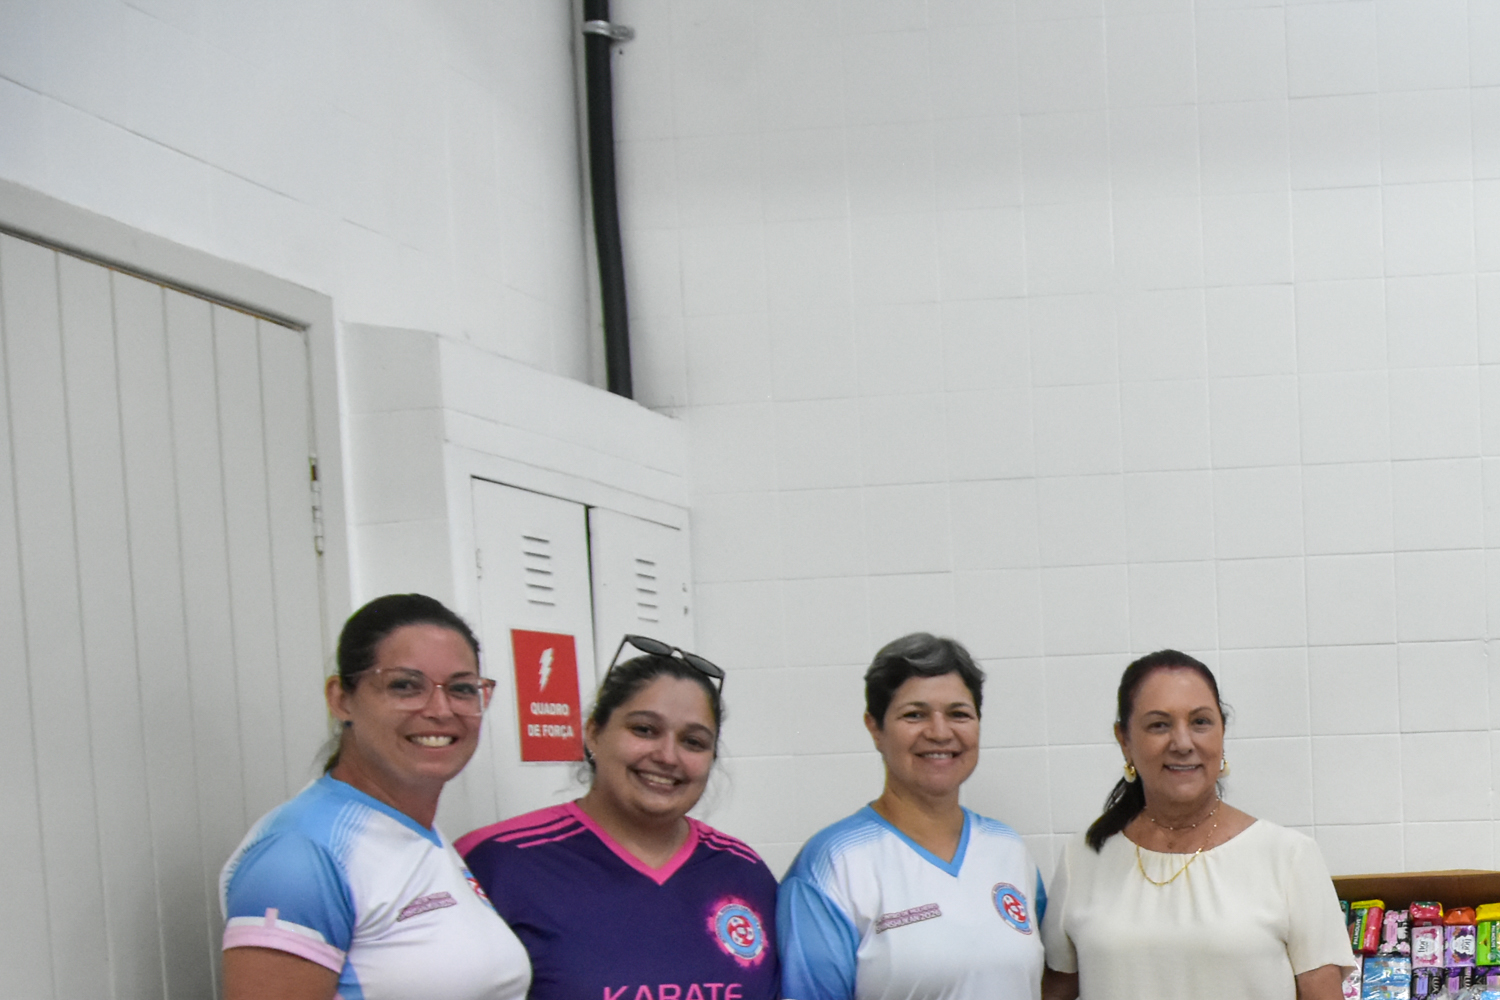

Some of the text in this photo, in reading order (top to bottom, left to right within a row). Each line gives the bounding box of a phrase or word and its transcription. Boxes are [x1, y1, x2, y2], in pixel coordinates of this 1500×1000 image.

[530, 702, 570, 716] QUADRO
[527, 724, 575, 740] DE FORÇA
[1353, 918, 1362, 945] PALMOLIVE
